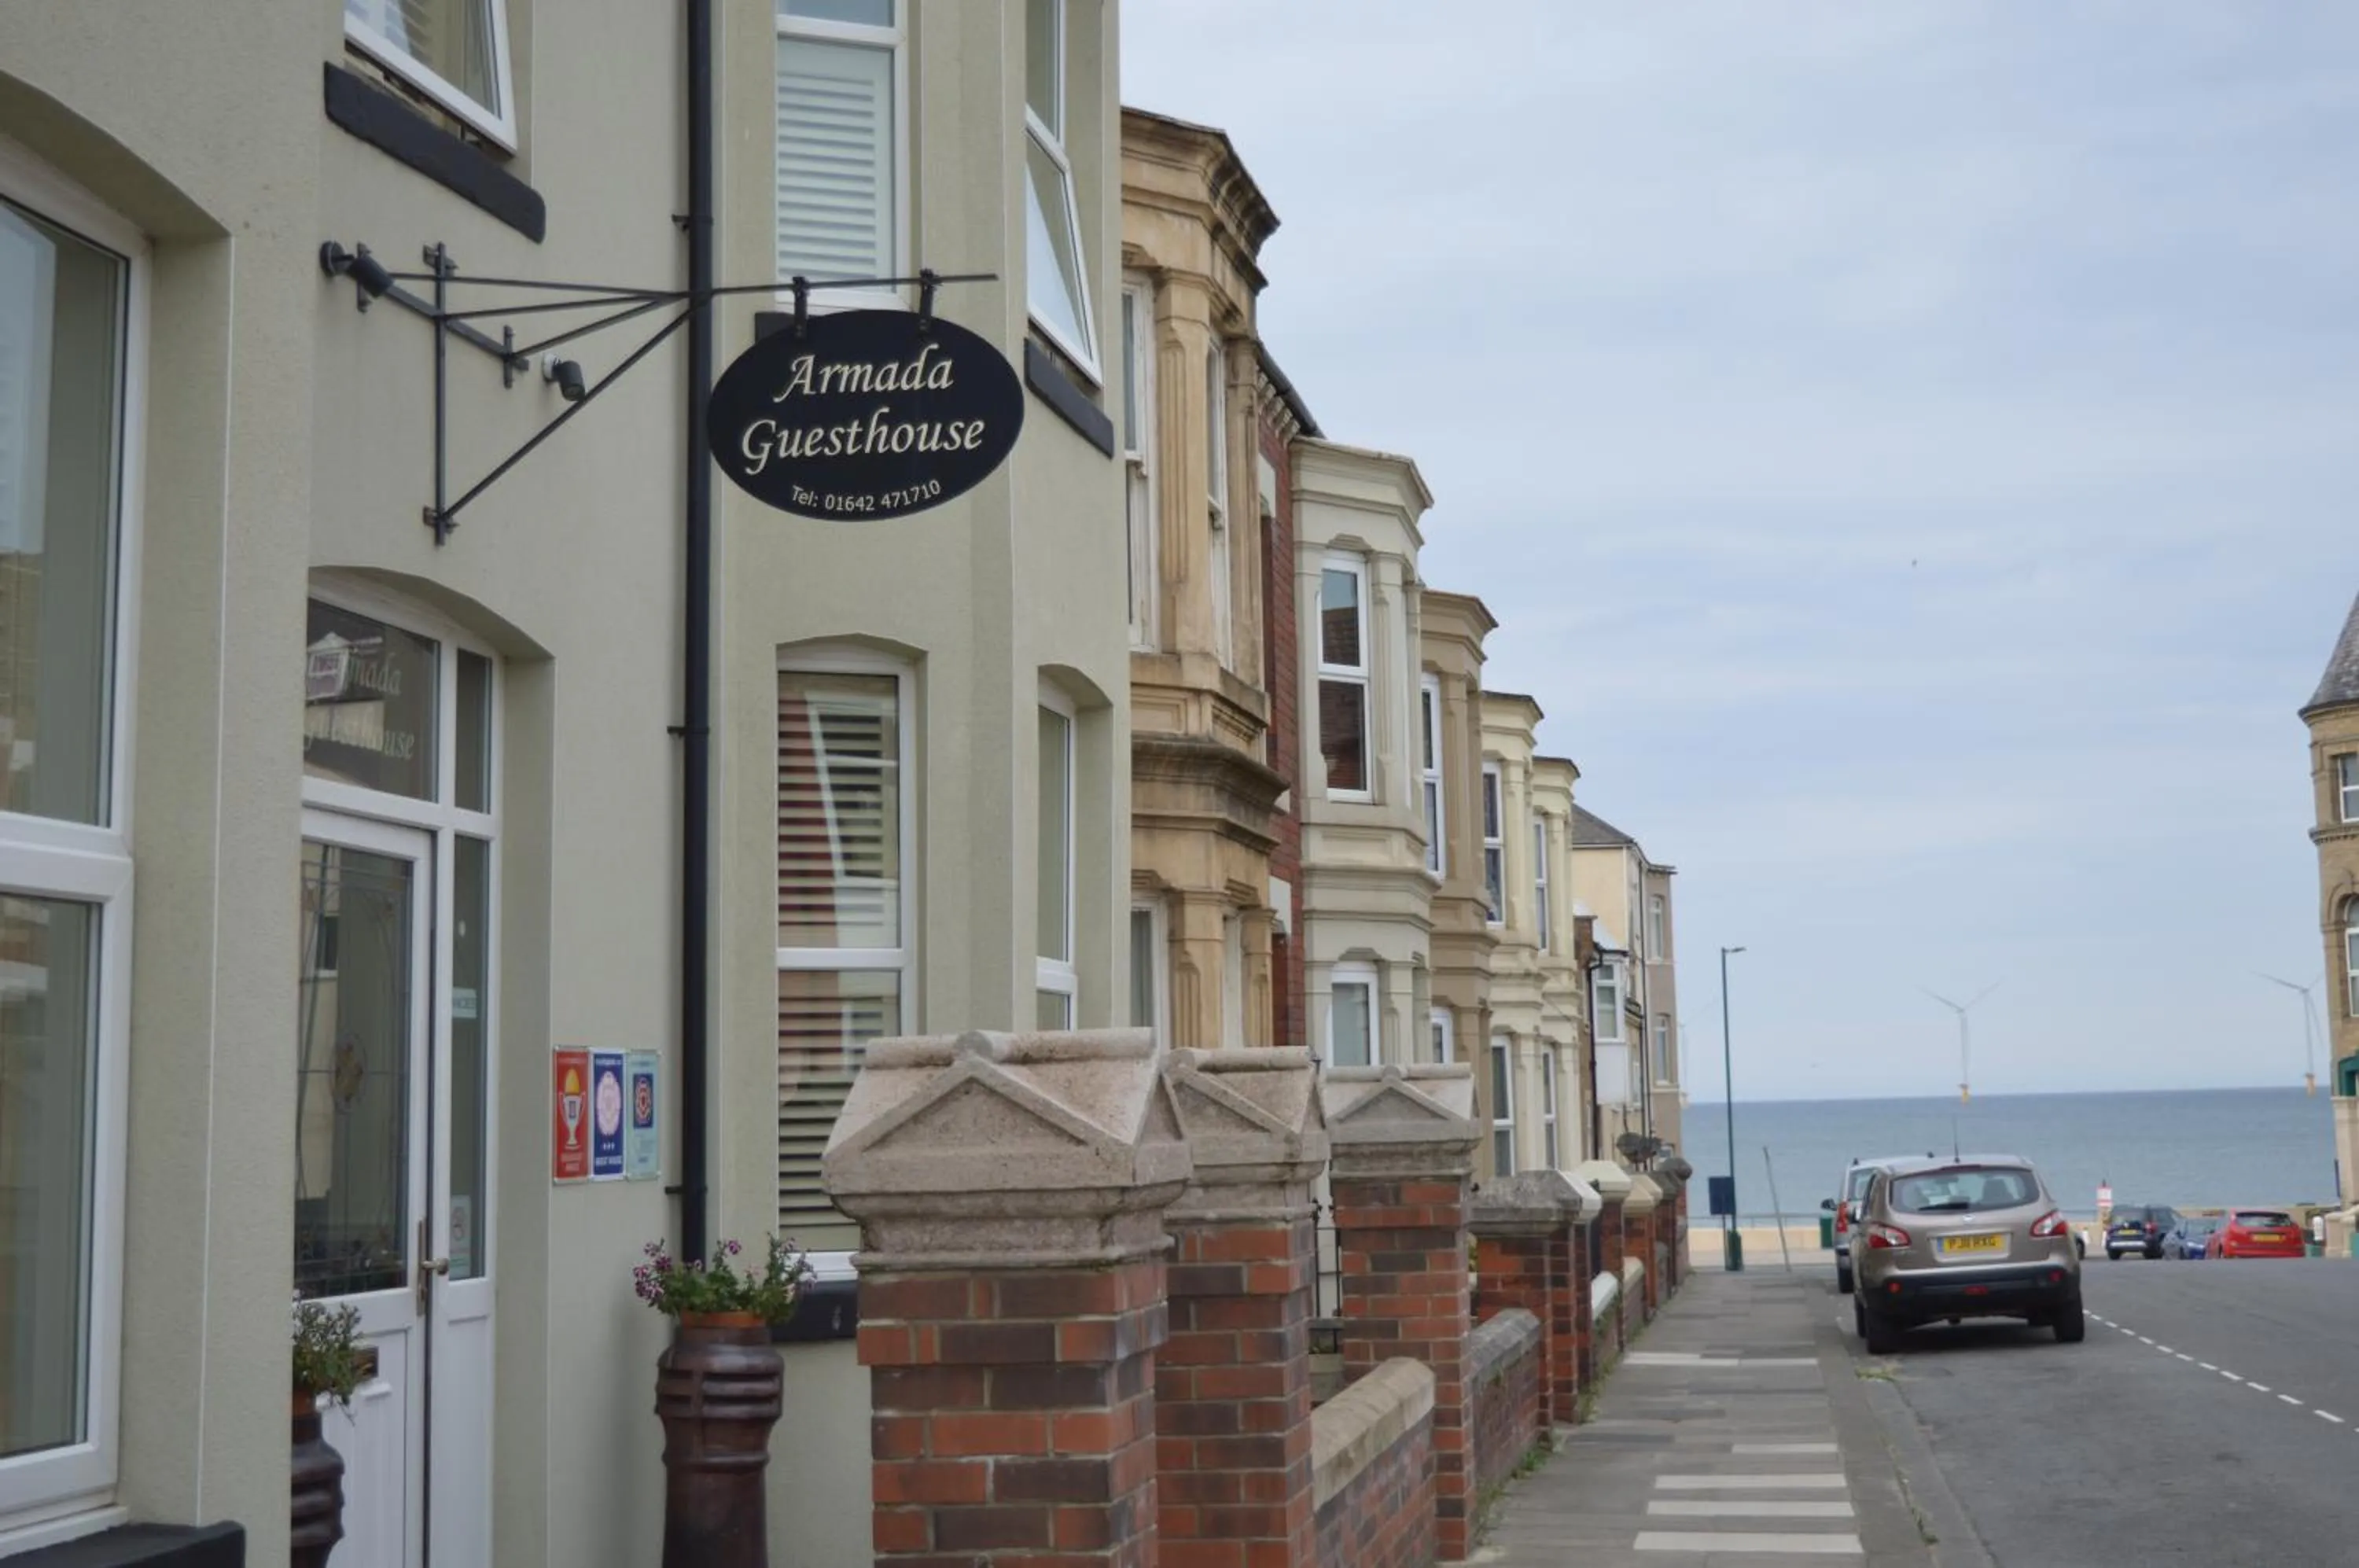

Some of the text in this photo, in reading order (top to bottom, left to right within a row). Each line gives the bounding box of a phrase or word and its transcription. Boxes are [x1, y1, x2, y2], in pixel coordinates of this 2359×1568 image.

[772, 342, 954, 403] Armada
[742, 406, 985, 476] Guesthouse
[791, 479, 941, 512] Tel: 01642 471710
